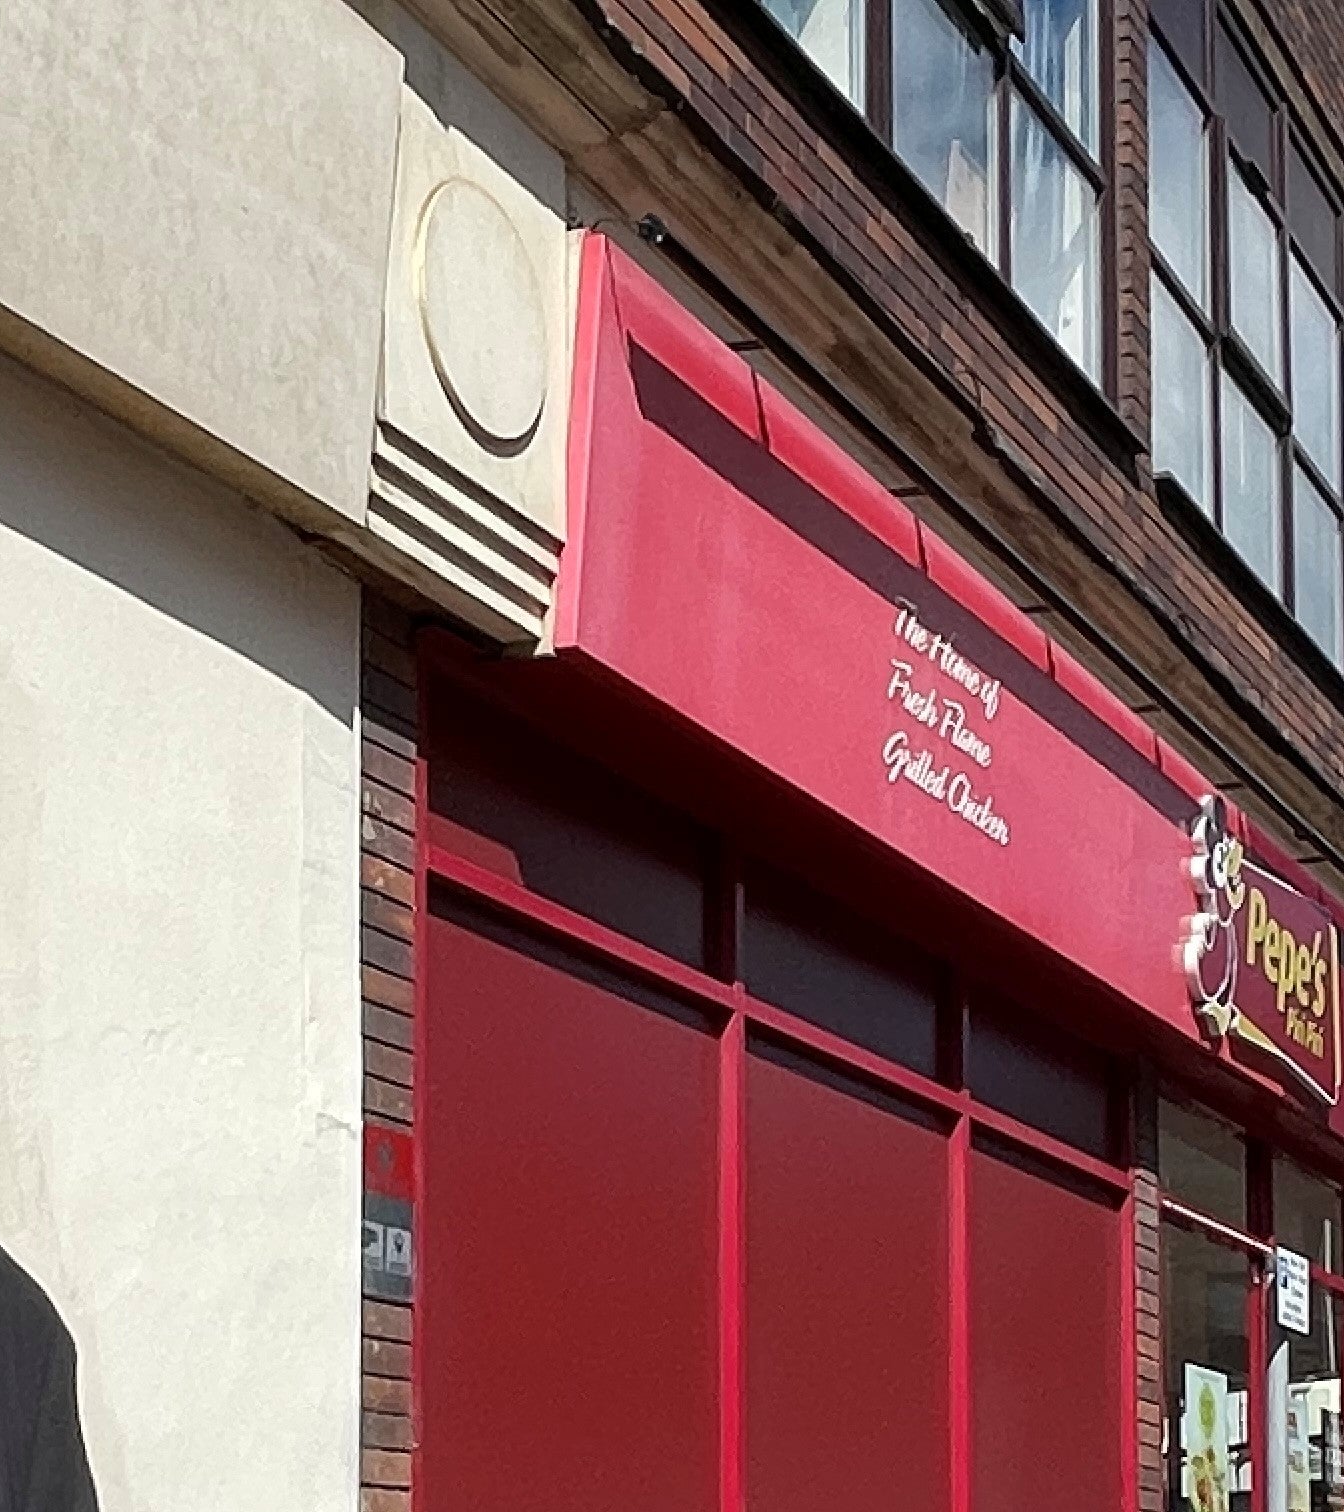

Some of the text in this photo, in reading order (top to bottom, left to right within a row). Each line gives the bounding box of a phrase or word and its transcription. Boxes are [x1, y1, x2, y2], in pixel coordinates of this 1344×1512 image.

[886, 658, 938, 729] Fresh
[882, 731, 948, 803] Grilled
[1246, 886, 1327, 1017] Pepe's
